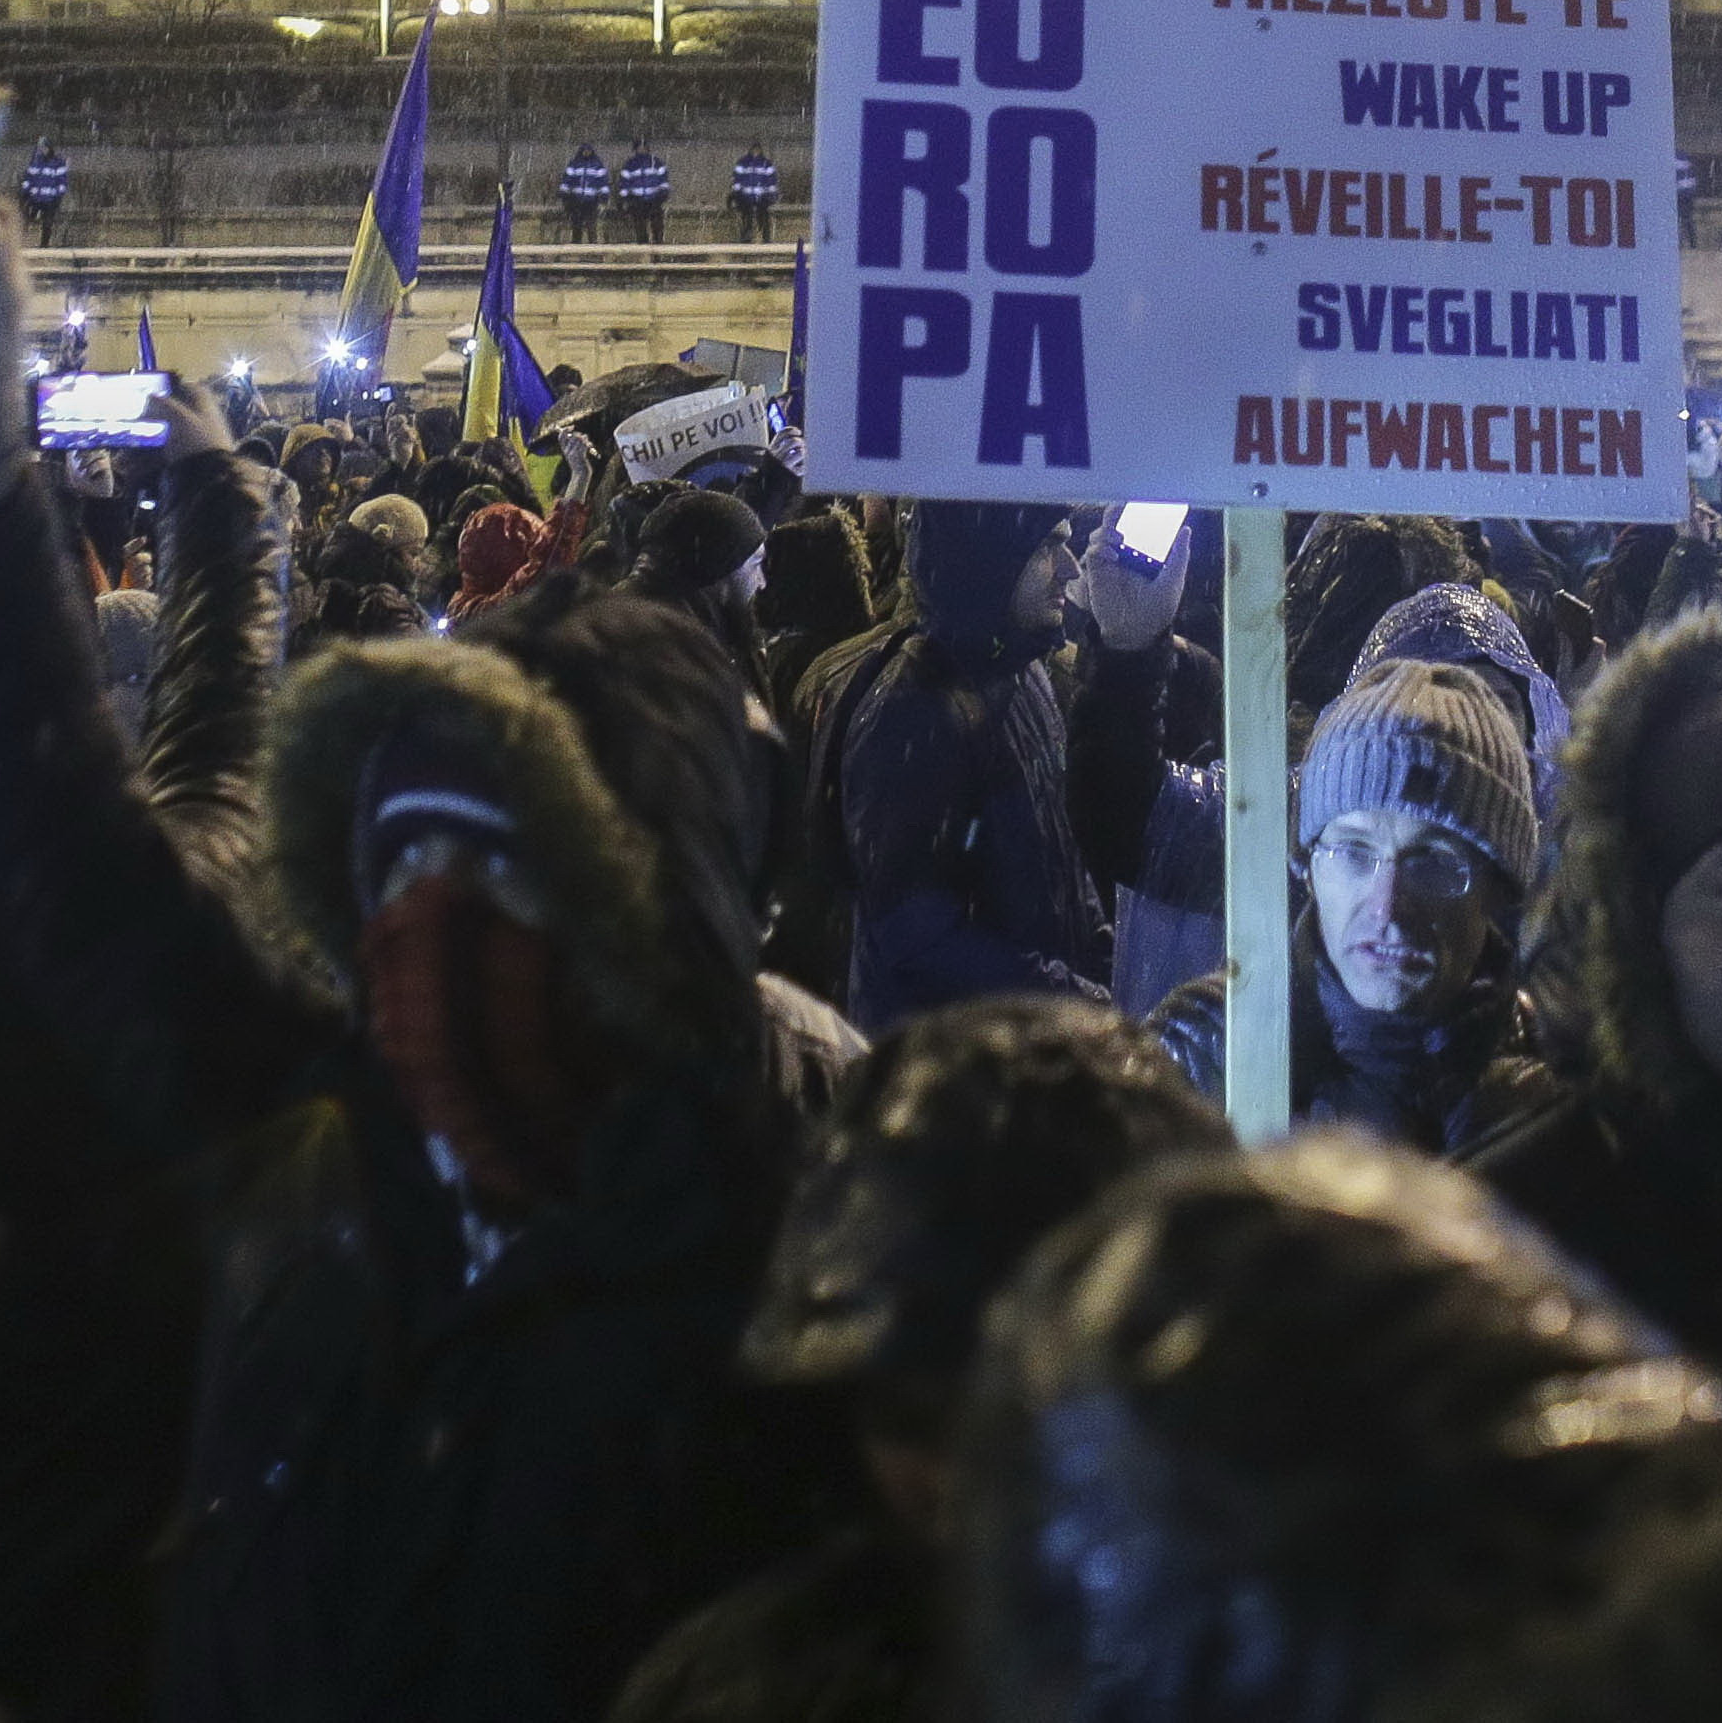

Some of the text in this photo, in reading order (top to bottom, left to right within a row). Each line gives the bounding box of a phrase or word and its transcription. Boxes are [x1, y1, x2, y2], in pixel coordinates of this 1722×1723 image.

[1340, 60, 1630, 136] WAKE UP
[858, 100, 1096, 277] RO
[1201, 148, 1637, 249] RÉVEILLE-TOI
[1298, 283, 1638, 361] SVEGLIATI
[856, 285, 1090, 468] PA
[671, 426, 700, 452] PE
[703, 409, 746, 439] VOI
[1234, 395, 1643, 477] AUFWACHEN
